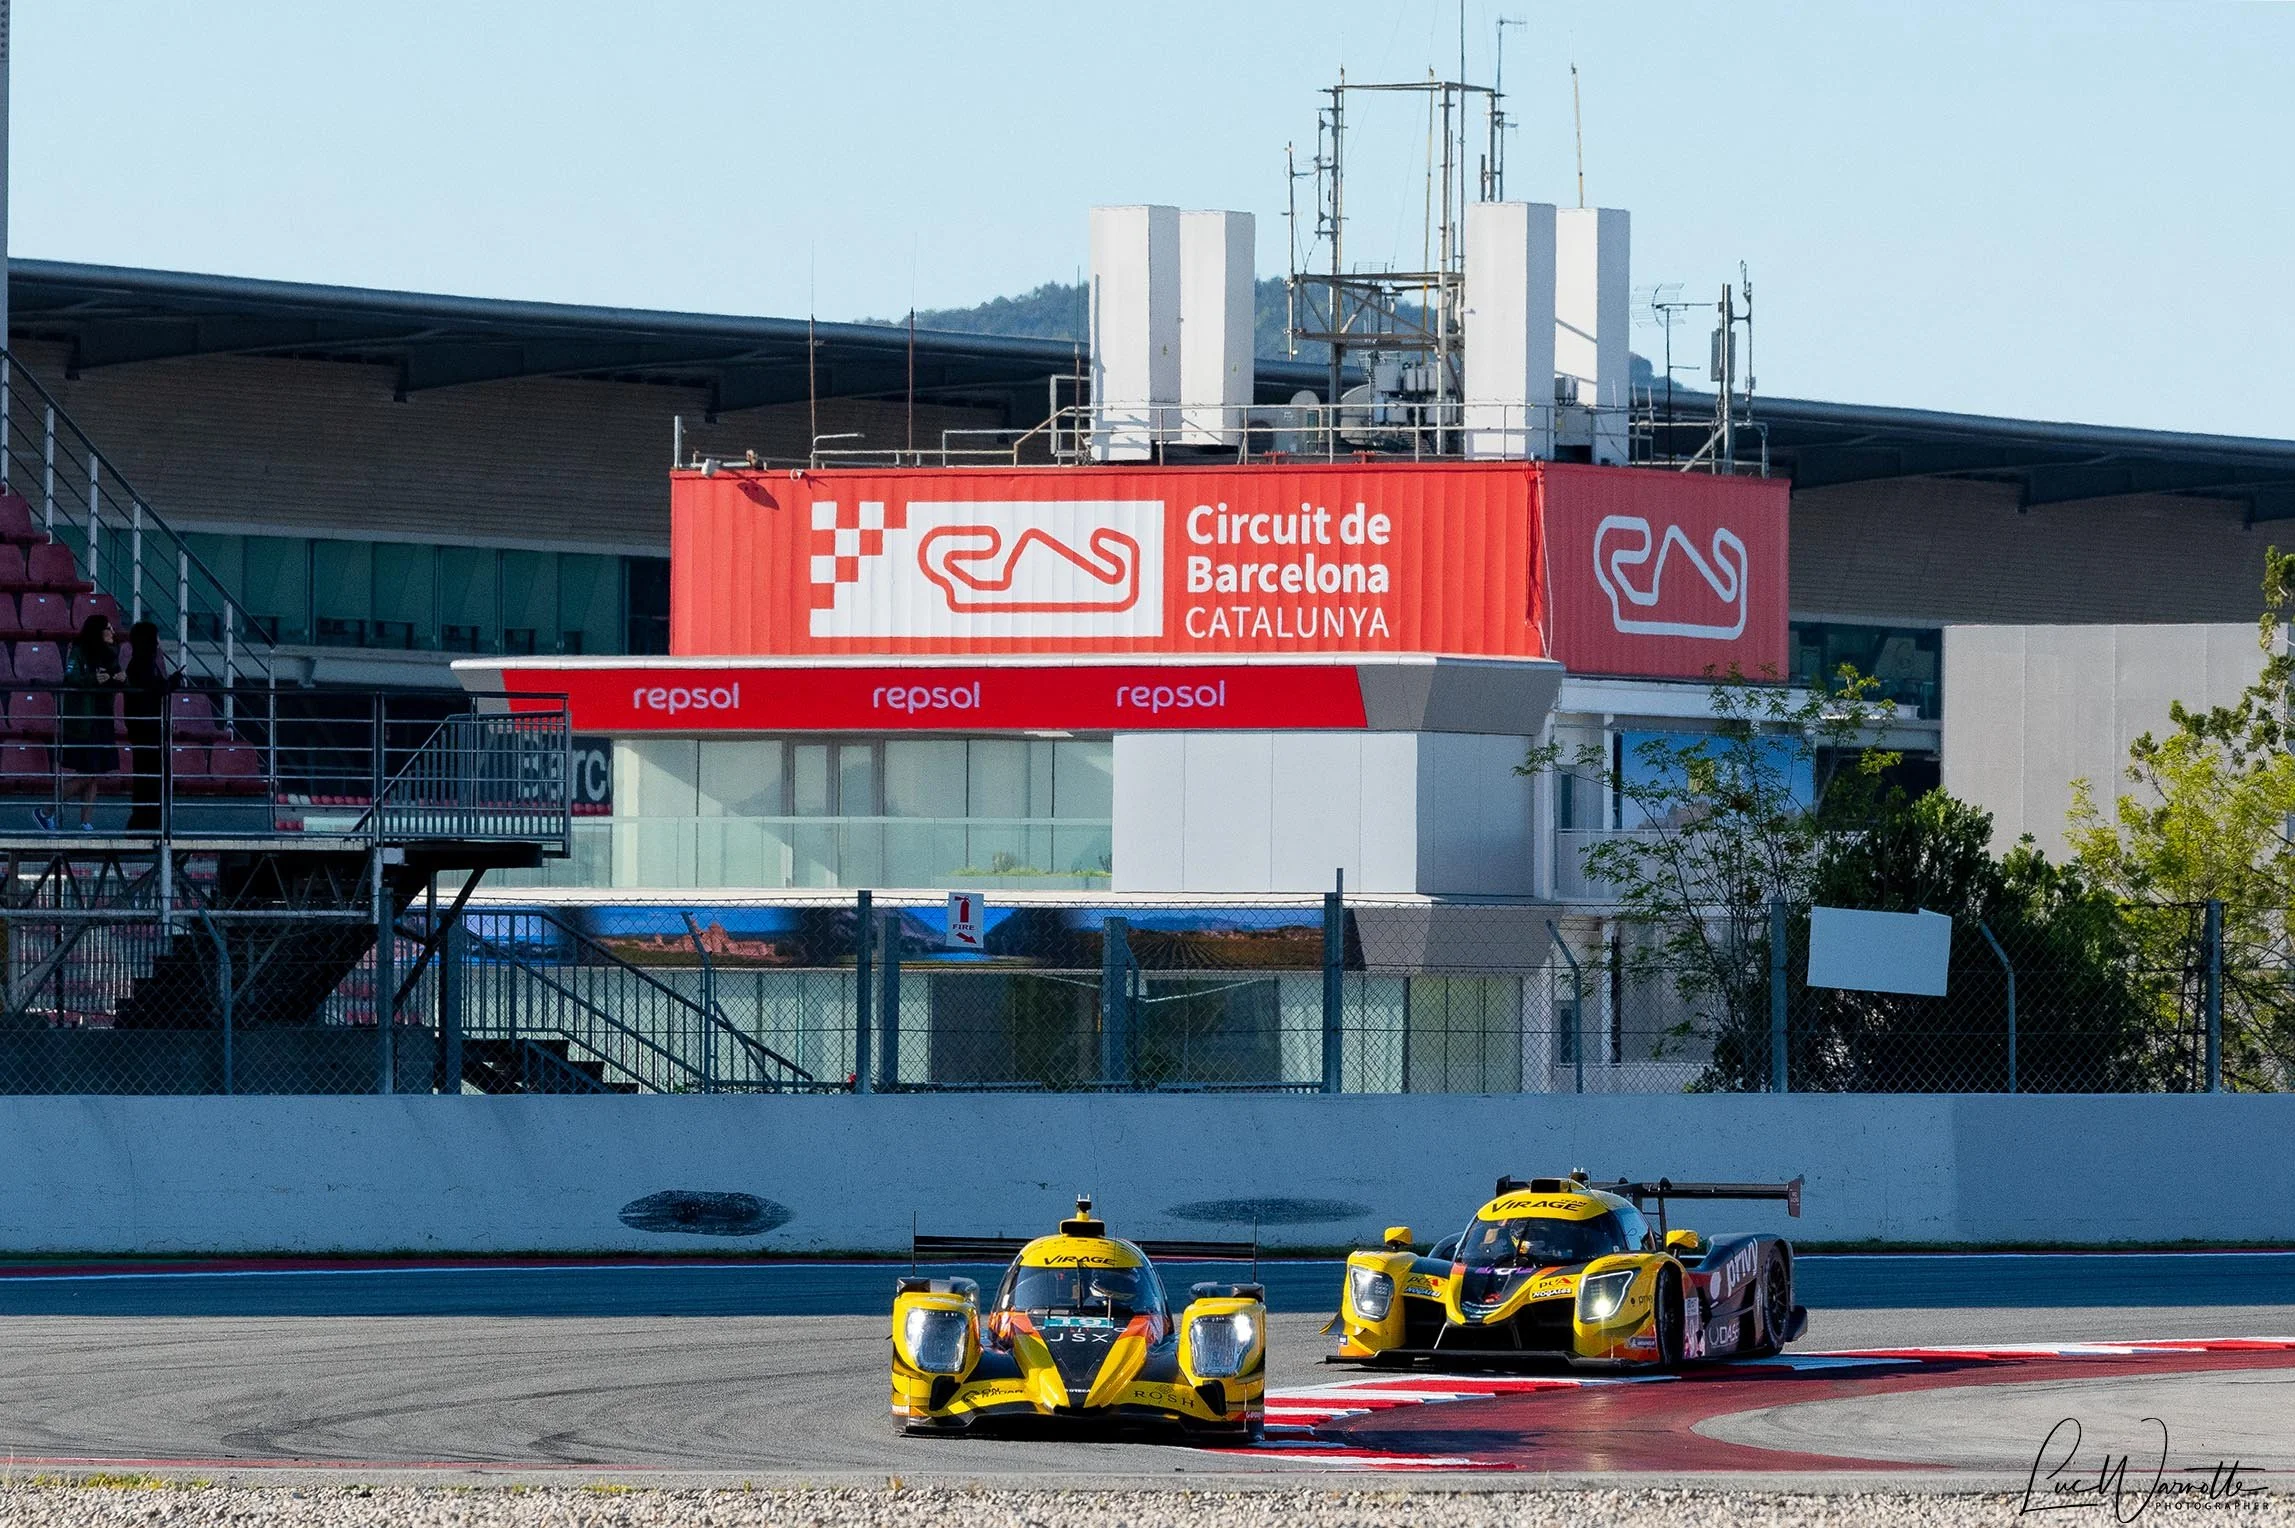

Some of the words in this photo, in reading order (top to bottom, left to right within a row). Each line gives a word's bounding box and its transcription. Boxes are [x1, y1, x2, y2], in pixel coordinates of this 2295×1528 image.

[1186, 502, 1331, 545] Circuit
[1340, 502, 1391, 545] de
[1187, 553, 1390, 594] Barcelona
[1185, 606, 1390, 639] CATALUNYA
[633, 681, 740, 714] repsol
[872, 681, 981, 713] repsol
[1116, 679, 1226, 713] repsol
[952, 923, 976, 931] FIRE
[1491, 1199, 1582, 1213] VIRAGE
[1043, 1255, 1118, 1266] VIRAGE
[1726, 1238, 1759, 1298] privy
[1050, 1333, 1109, 1343] JSX
[1133, 1390, 1195, 1409] ROSH
